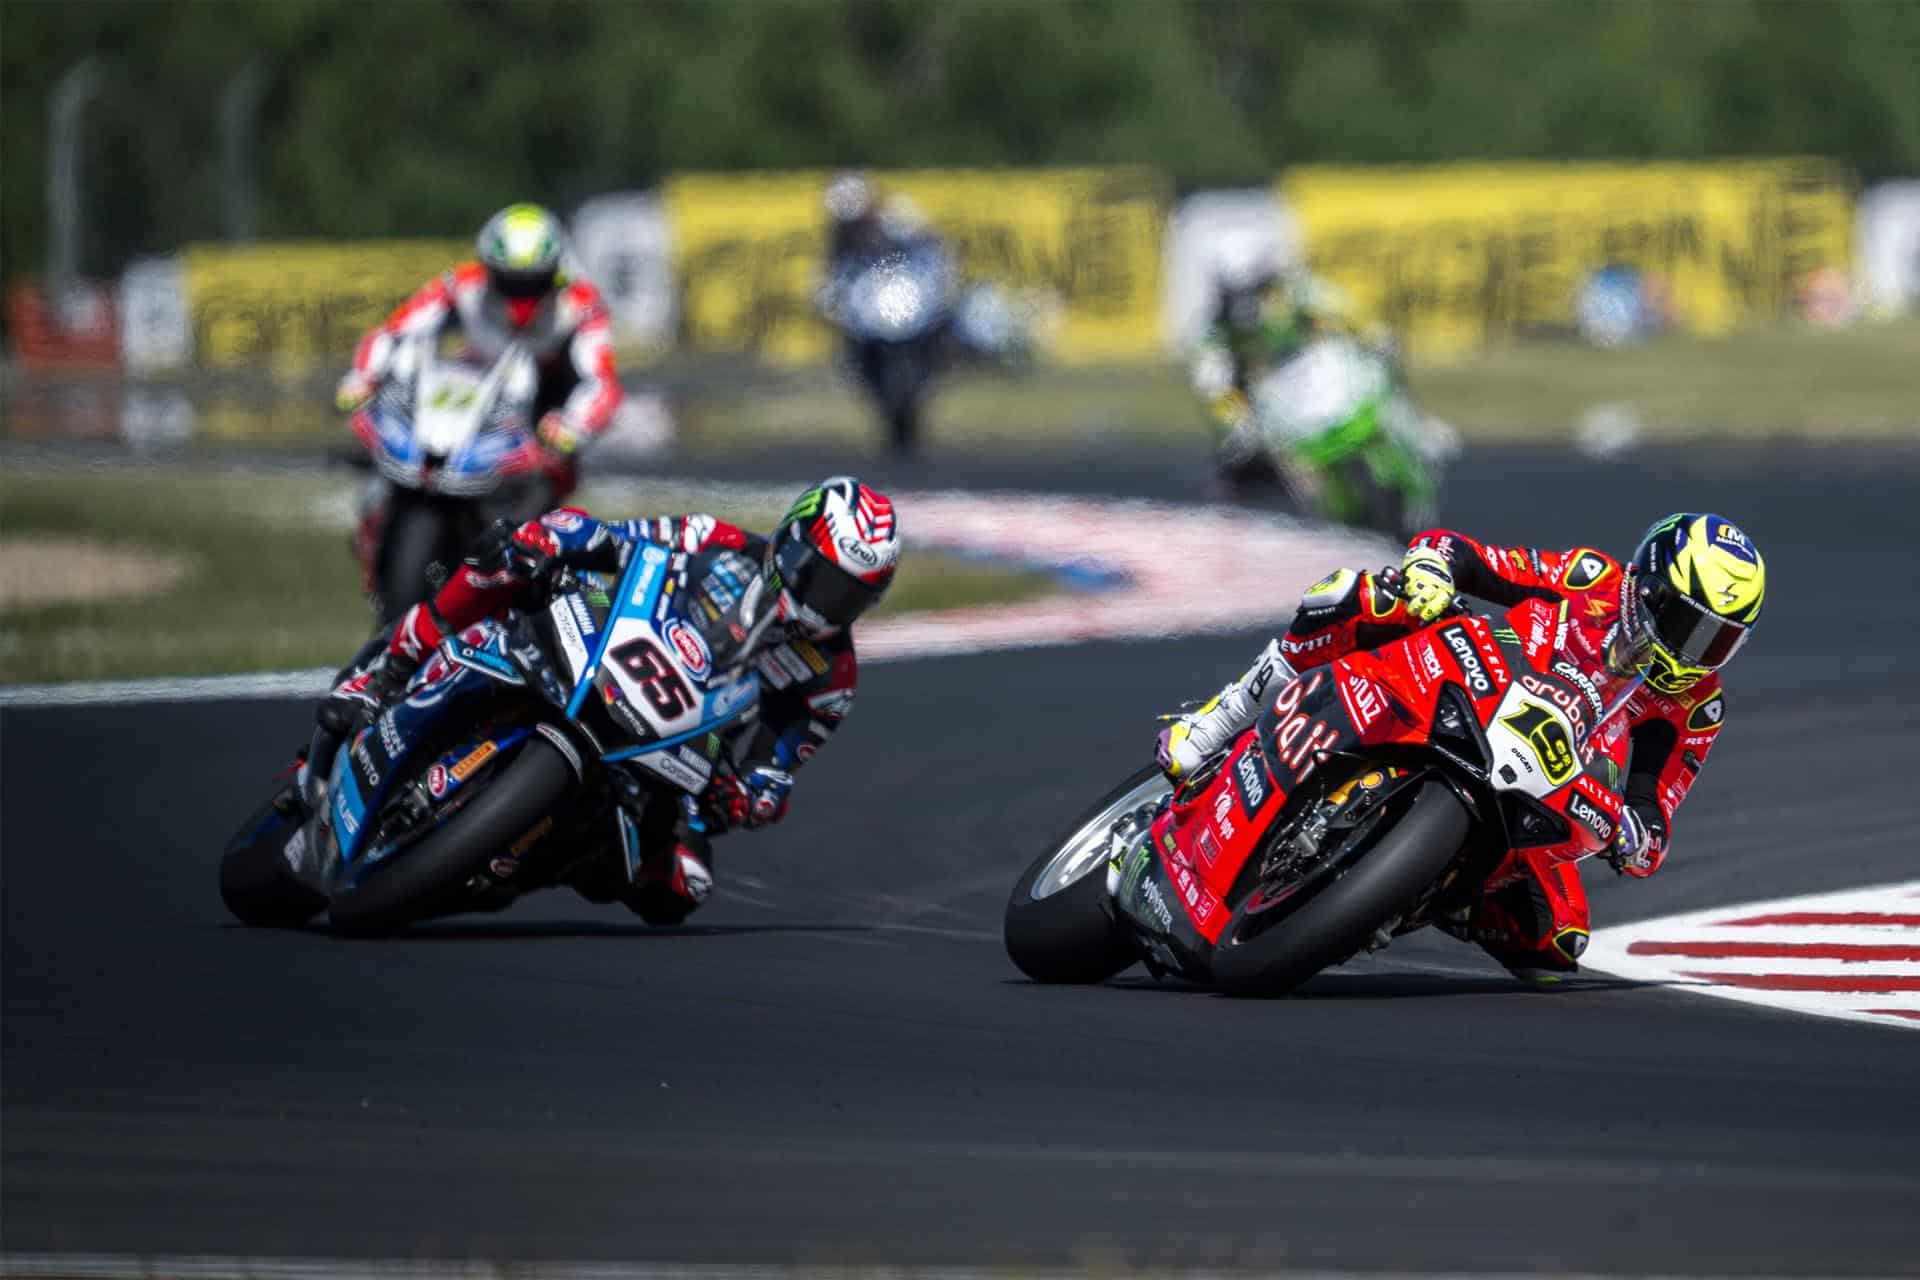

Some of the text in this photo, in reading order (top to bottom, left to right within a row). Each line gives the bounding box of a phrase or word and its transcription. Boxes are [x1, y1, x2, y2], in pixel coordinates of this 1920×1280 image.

[1280, 633, 1332, 654] EV'IT!
[1444, 627, 1489, 690] Lenovo
[1468, 617, 1508, 683] ALTEN
[607, 637, 697, 722] 65
[1498, 698, 1576, 787] 19
[1521, 674, 1595, 765] aruba.it
[1237, 751, 1265, 807] Lenovo
[1511, 747, 1533, 773] DUCATI
[1570, 795, 1612, 839] Lenovo
[1579, 777, 1622, 815] ALTEN
